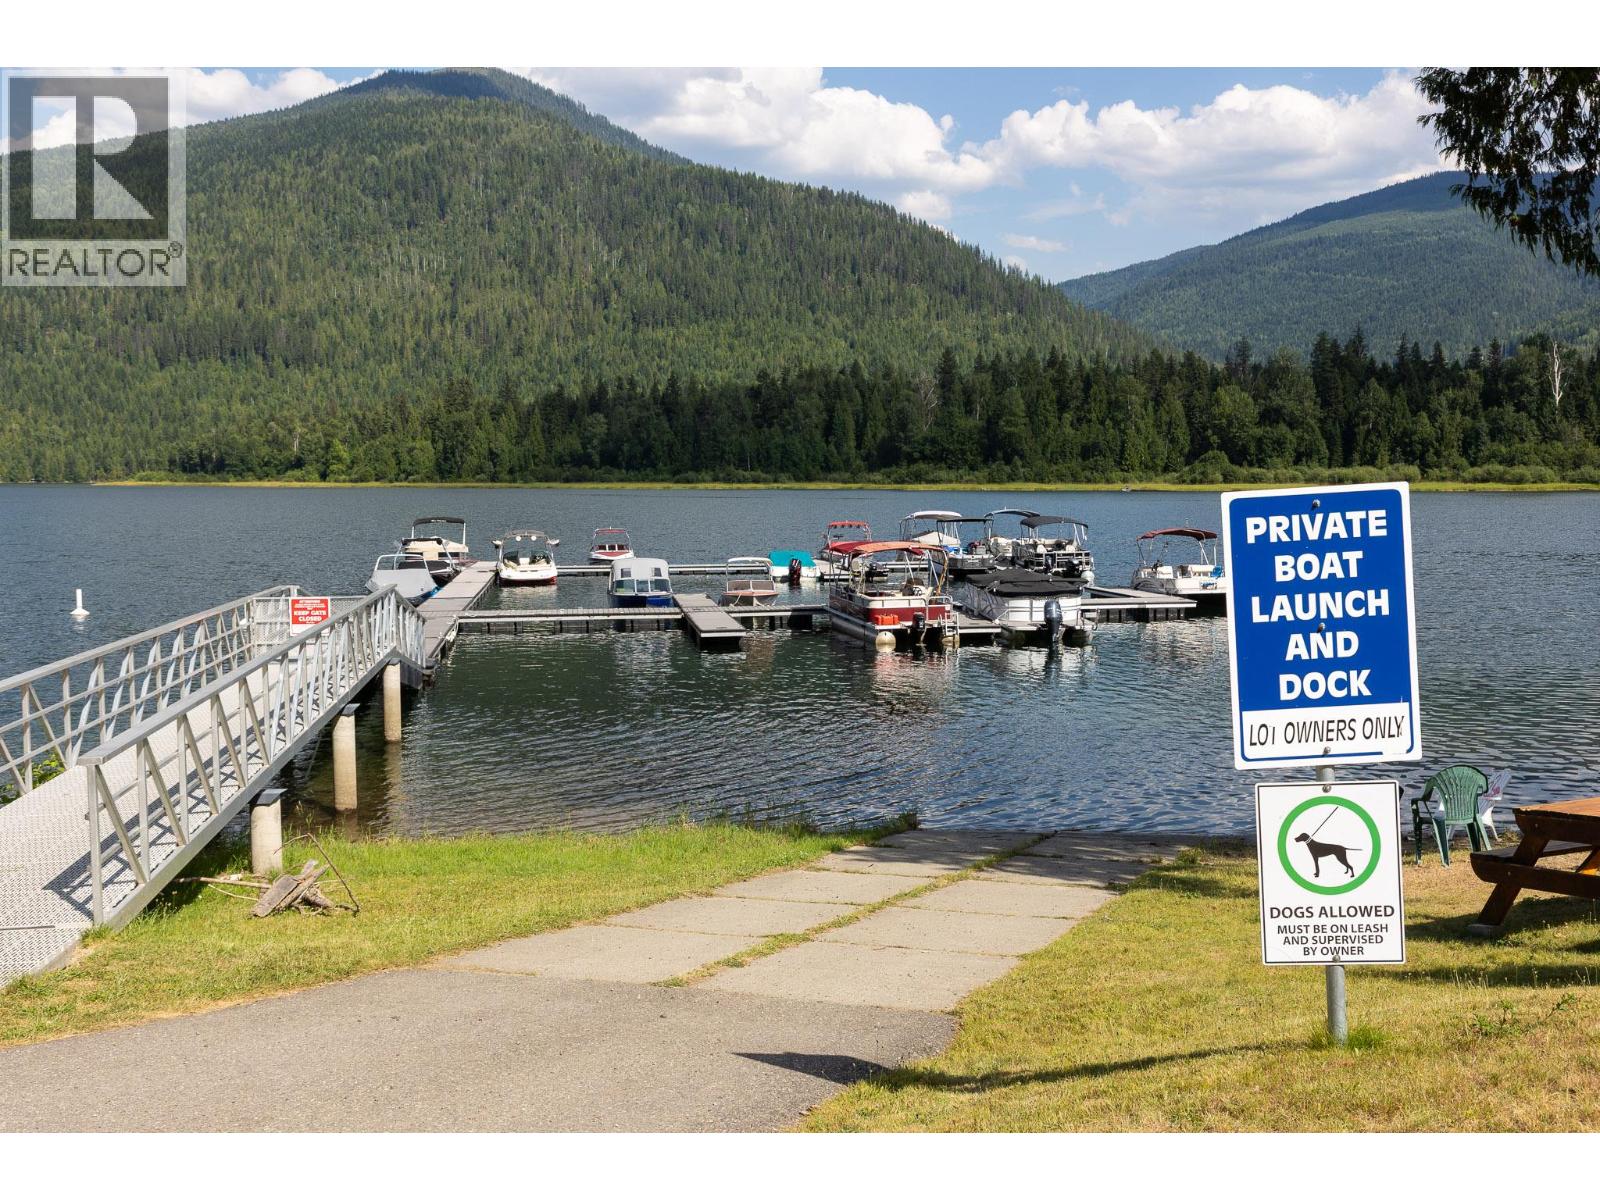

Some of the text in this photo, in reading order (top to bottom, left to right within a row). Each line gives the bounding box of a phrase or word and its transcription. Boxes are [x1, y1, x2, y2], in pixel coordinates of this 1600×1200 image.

[1246, 509, 1387, 544] PRIVATE
[1274, 551, 1363, 582] BOAT
[1251, 589, 1389, 623] LAUNCH
[1285, 631, 1359, 661] AND
[1279, 670, 1371, 701] DOCK
[1284, 718, 1356, 744] OWNERS
[1362, 716, 1405, 739] ONLY
[1270, 905, 1395, 919] DOGS ALLOWED
[1277, 924, 1388, 934] MUST BE ON LEASH
[1283, 935, 1383, 945] AND SUPERVISED
[1303, 946, 1364, 955] BY OWNER
